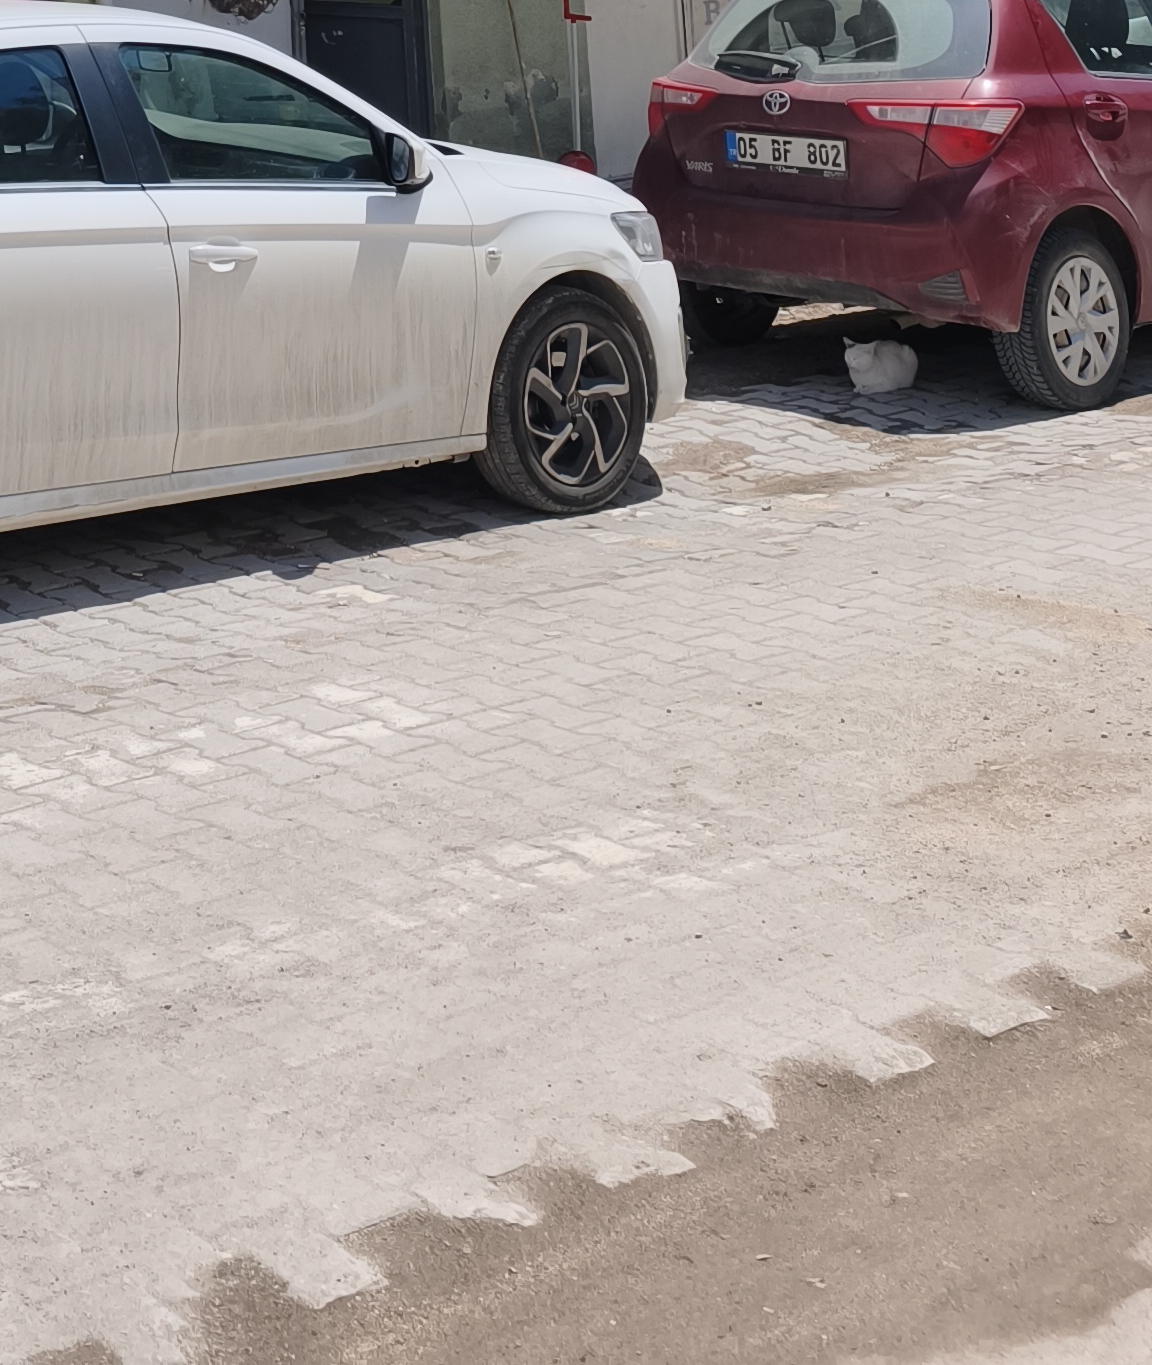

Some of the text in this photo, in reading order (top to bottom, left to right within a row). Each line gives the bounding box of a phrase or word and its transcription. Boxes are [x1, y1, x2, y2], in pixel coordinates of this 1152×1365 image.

[737, 136, 842, 168] 05 BF 802
